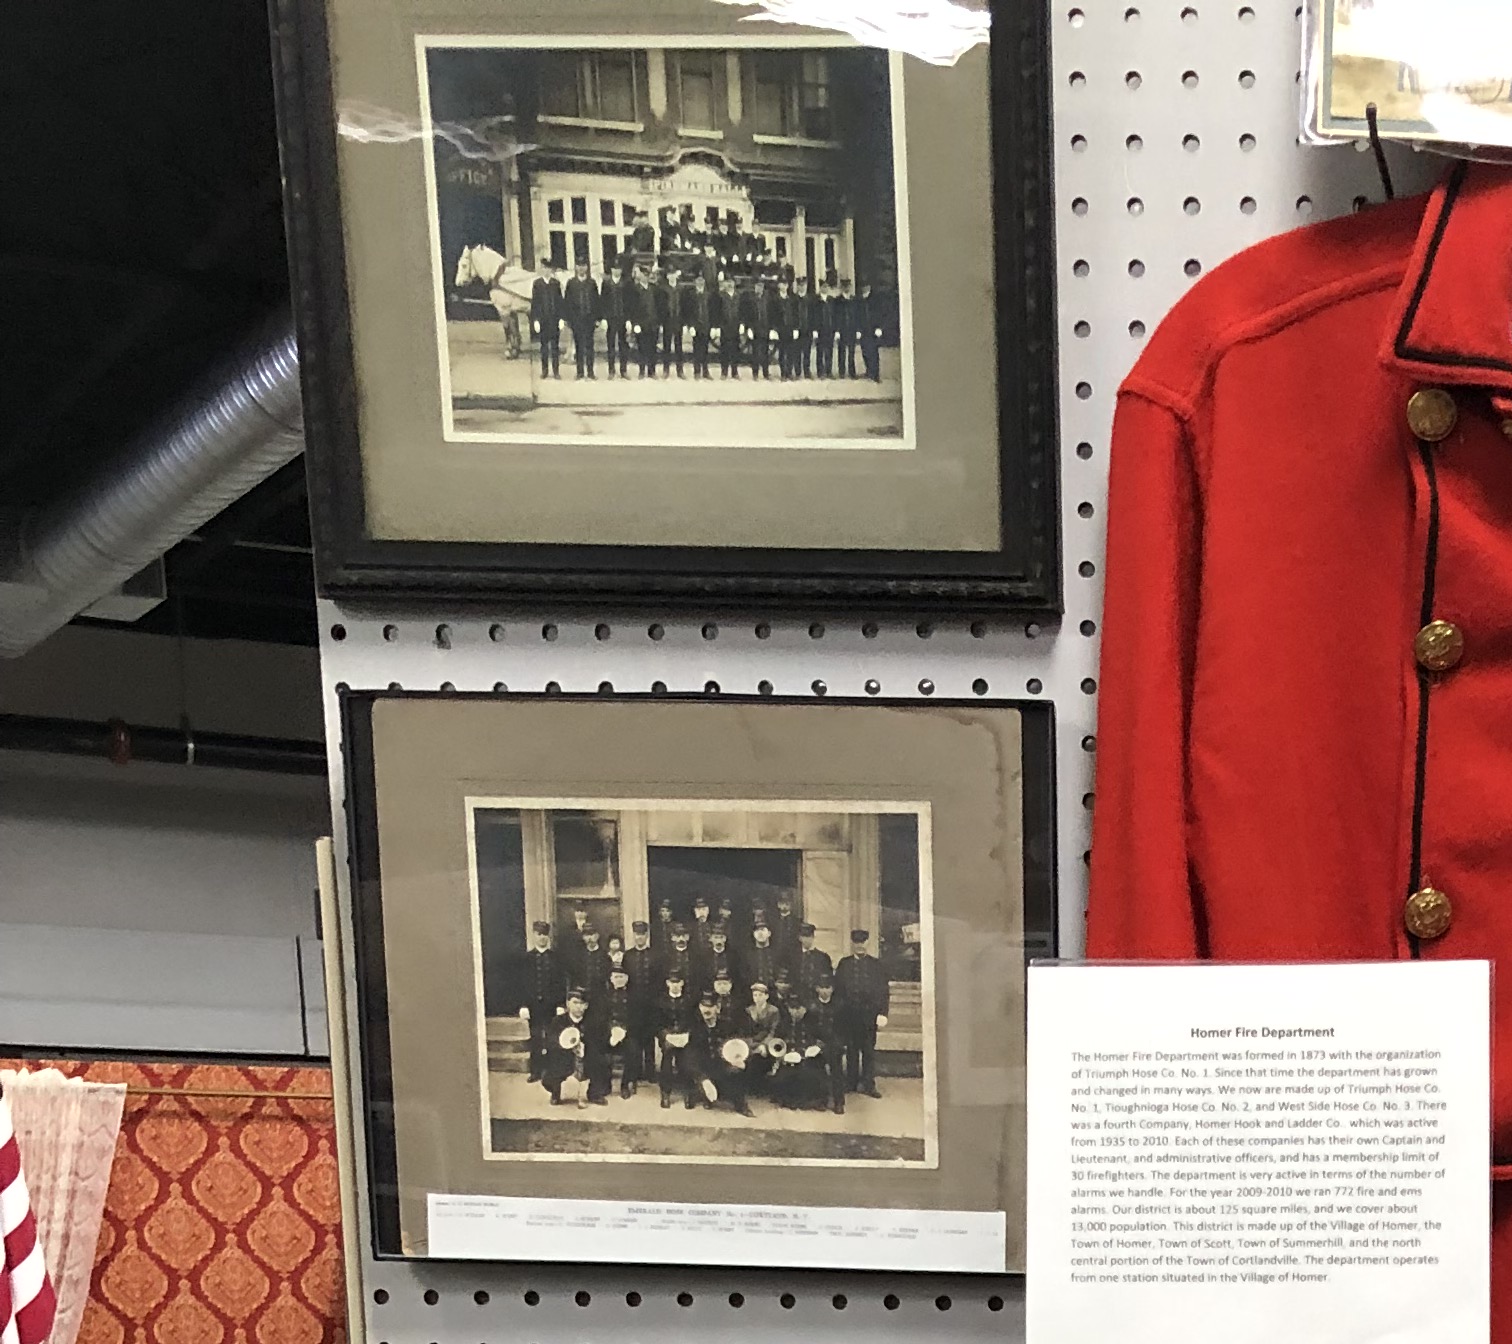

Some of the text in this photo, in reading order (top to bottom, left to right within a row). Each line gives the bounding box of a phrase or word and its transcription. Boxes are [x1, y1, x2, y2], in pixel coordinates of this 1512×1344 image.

[1190, 1027, 1334, 1039] Homer Fire Department
[1071, 1049, 1441, 1063] The Homer Fire Department was formed in 1873 with the organization
[1070, 1085, 1091, 1095] and
[1093, 1085, 1138, 1097] changed
[1140, 1085, 1150, 1095] in
[1153, 1087, 1182, 1097] many
[1217, 1084, 1235, 1095] We
[1238, 1087, 1261, 1095] now
[1284, 1084, 1314, 1094] made
[1317, 1086, 1331, 1096] up
[1333, 1084, 1344, 1094] of
[1348, 1084, 1391, 1096] Triumph
[1394, 1083, 1421, 1094] Hose
[1070, 1136, 1096, 1146] from
[1100, 1136, 1125, 1146] 1935
[1128, 1136, 1139, 1146] to
[1174, 1136, 1199, 1146] Each
[1202, 1136, 1213, 1146] of
[1215, 1135, 1245, 1146] these
[1247, 1135, 1304, 1147] companies
[1307, 1135, 1325, 1145] has
[1328, 1135, 1353, 1145] their
[1356, 1137, 1379, 1145] own
[1382, 1135, 1422, 1147] Captain
[1425, 1134, 1445, 1145] and
[1133, 1153, 1153, 1163] and
[1156, 1153, 1231, 1163] administrative
[1279, 1152, 1300, 1162] and
[1302, 1152, 1320, 1162] has
[1323, 1154, 1329, 1162] a
[1332, 1152, 1399, 1164] membership
[1401, 1151, 1425, 1162] limit
[1427, 1151, 1439, 1162] of
[1071, 1170, 1084, 1180] 30
[1151, 1169, 1170, 1180] The
[1173, 1169, 1236, 1182] department
[1238, 1169, 1247, 1179] is
[1249, 1171, 1272, 1181] very
[1275, 1169, 1307, 1179] active
[1309, 1169, 1319, 1179] in
[1322, 1169, 1352, 1179] terms
[1355, 1169, 1366, 1179] of
[1369, 1169, 1386, 1179] the
[1390, 1168, 1431, 1179] number
[1434, 1168, 1445, 1178] of
[1070, 1187, 1106, 1197] alarms
[1109, 1189, 1124, 1197] we
[1169, 1187, 1188, 1197] For
[1189, 1187, 1207, 1197] the
[1210, 1189, 1232, 1199] year
[1236, 1186, 1292, 1197] 2009-2010
[1333, 1186, 1353, 1196] 772
[1356, 1186, 1374, 1196] fire
[1377, 1186, 1397, 1196] and
[1399, 1188, 1422, 1196] ems
[1070, 1255, 1107, 1265] central
[1110, 1255, 1149, 1267] portion
[1151, 1255, 1163, 1265] of
[1165, 1255, 1183, 1265] the
[1187, 1255, 1215, 1265] Town
[1217, 1255, 1229, 1265] of
[1303, 1254, 1324, 1264] The
[1326, 1254, 1389, 1266] department
[1392, 1254, 1439, 1266] operates
